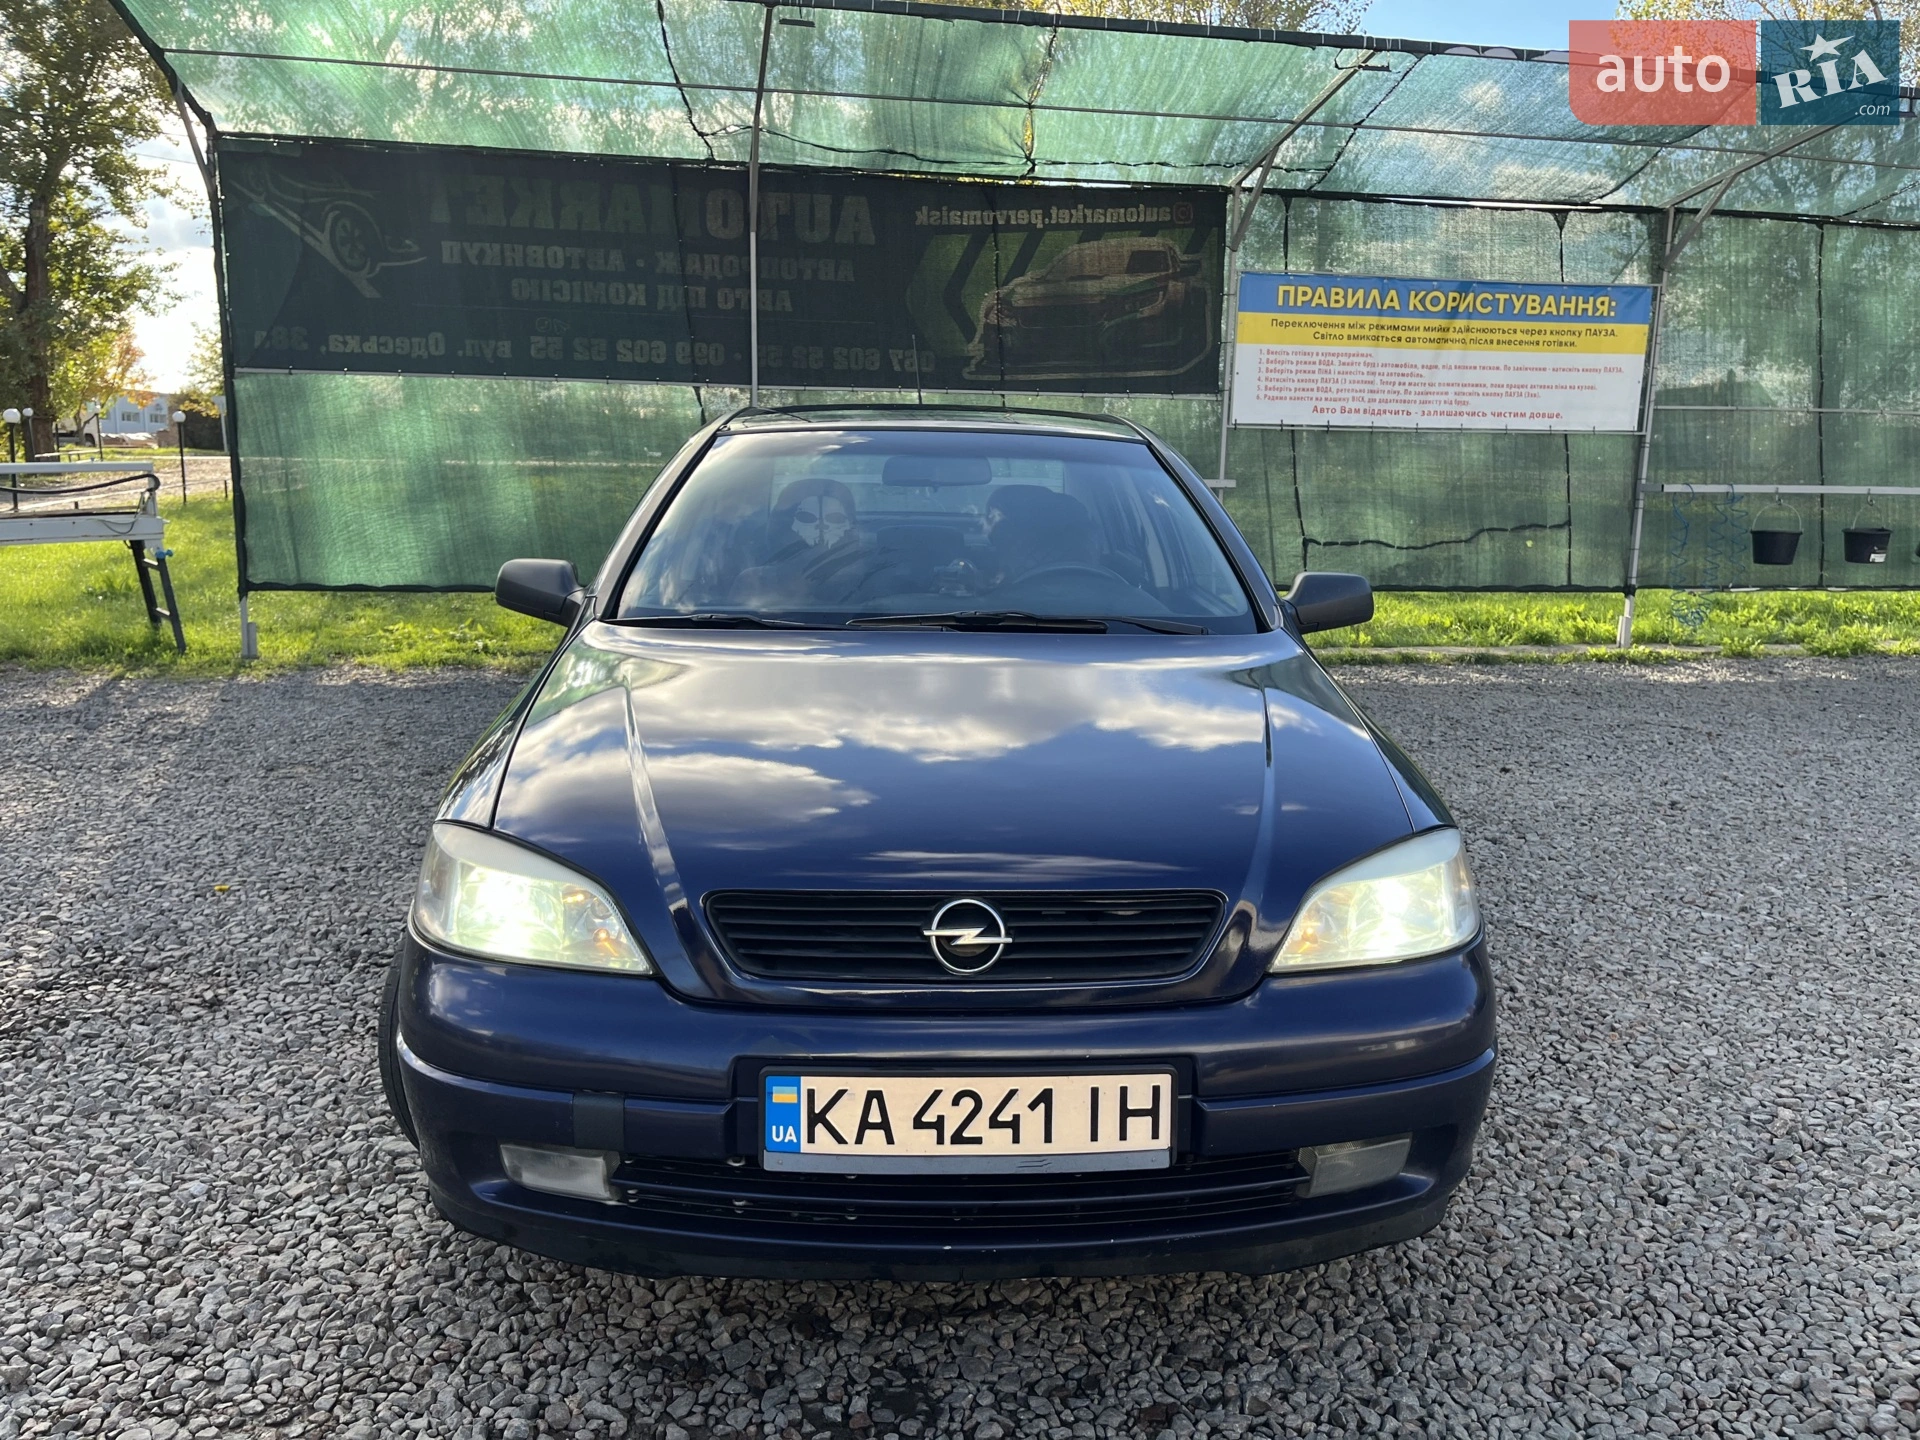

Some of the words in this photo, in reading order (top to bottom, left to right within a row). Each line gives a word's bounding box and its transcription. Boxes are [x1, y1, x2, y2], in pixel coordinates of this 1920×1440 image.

[1277, 284, 1401, 311] ПРАВИЛА
[1408, 290, 1617, 318] КОРИСТУВАННЯ:
[1271, 319, 1345, 328] Переключення
[1369, 324, 1420, 332] режимами
[1452, 326, 1517, 334] здійснюються
[1520, 329, 1547, 337] через
[1550, 330, 1582, 338] кнопку
[1585, 328, 1618, 337] ПАУЗА.
[1313, 332, 1344, 340] Світло
[1469, 336, 1494, 344] після
[1380, 379, 1396, 387] Тепер
[1312, 405, 1336, 413] Авто
[1340, 406, 1360, 414] Вам
[1363, 408, 1412, 416] віддячить
[806, 1087, 895, 1146] KA
[912, 1087, 1053, 1146] 4241
[1089, 1085, 1160, 1142] IH
[772, 1126, 797, 1144] UA
